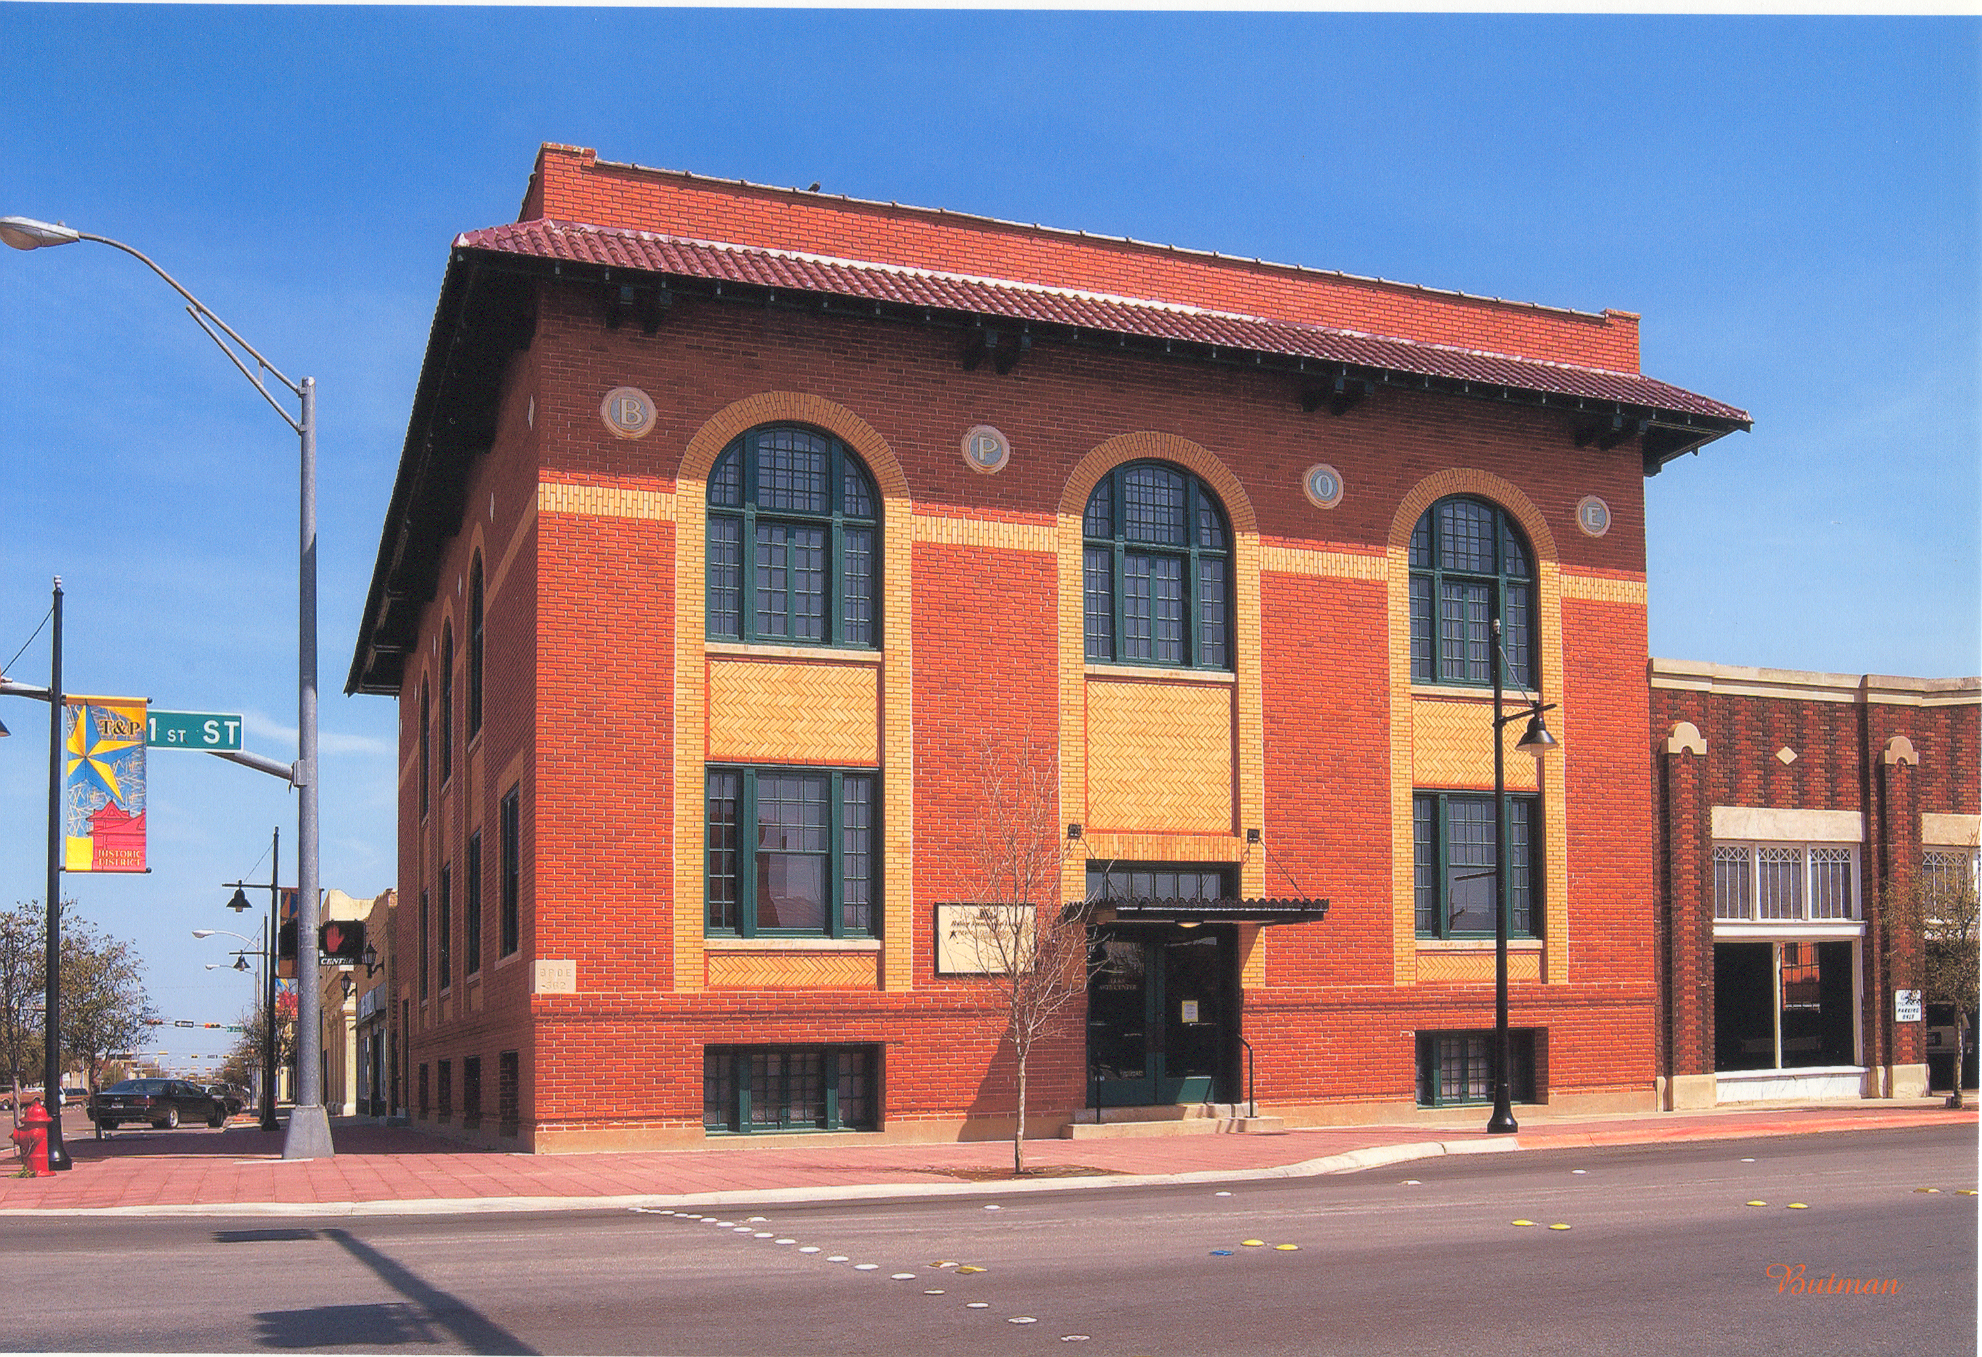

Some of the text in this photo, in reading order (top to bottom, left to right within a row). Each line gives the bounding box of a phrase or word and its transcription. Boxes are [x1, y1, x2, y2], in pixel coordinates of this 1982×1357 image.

[620, 397, 1602, 526] B P O E
[101, 719, 141, 736] T&P
[202, 719, 240, 745] ST
[98, 849, 142, 858] HISTORIC
[98, 858, 141, 867] DISTRICT
